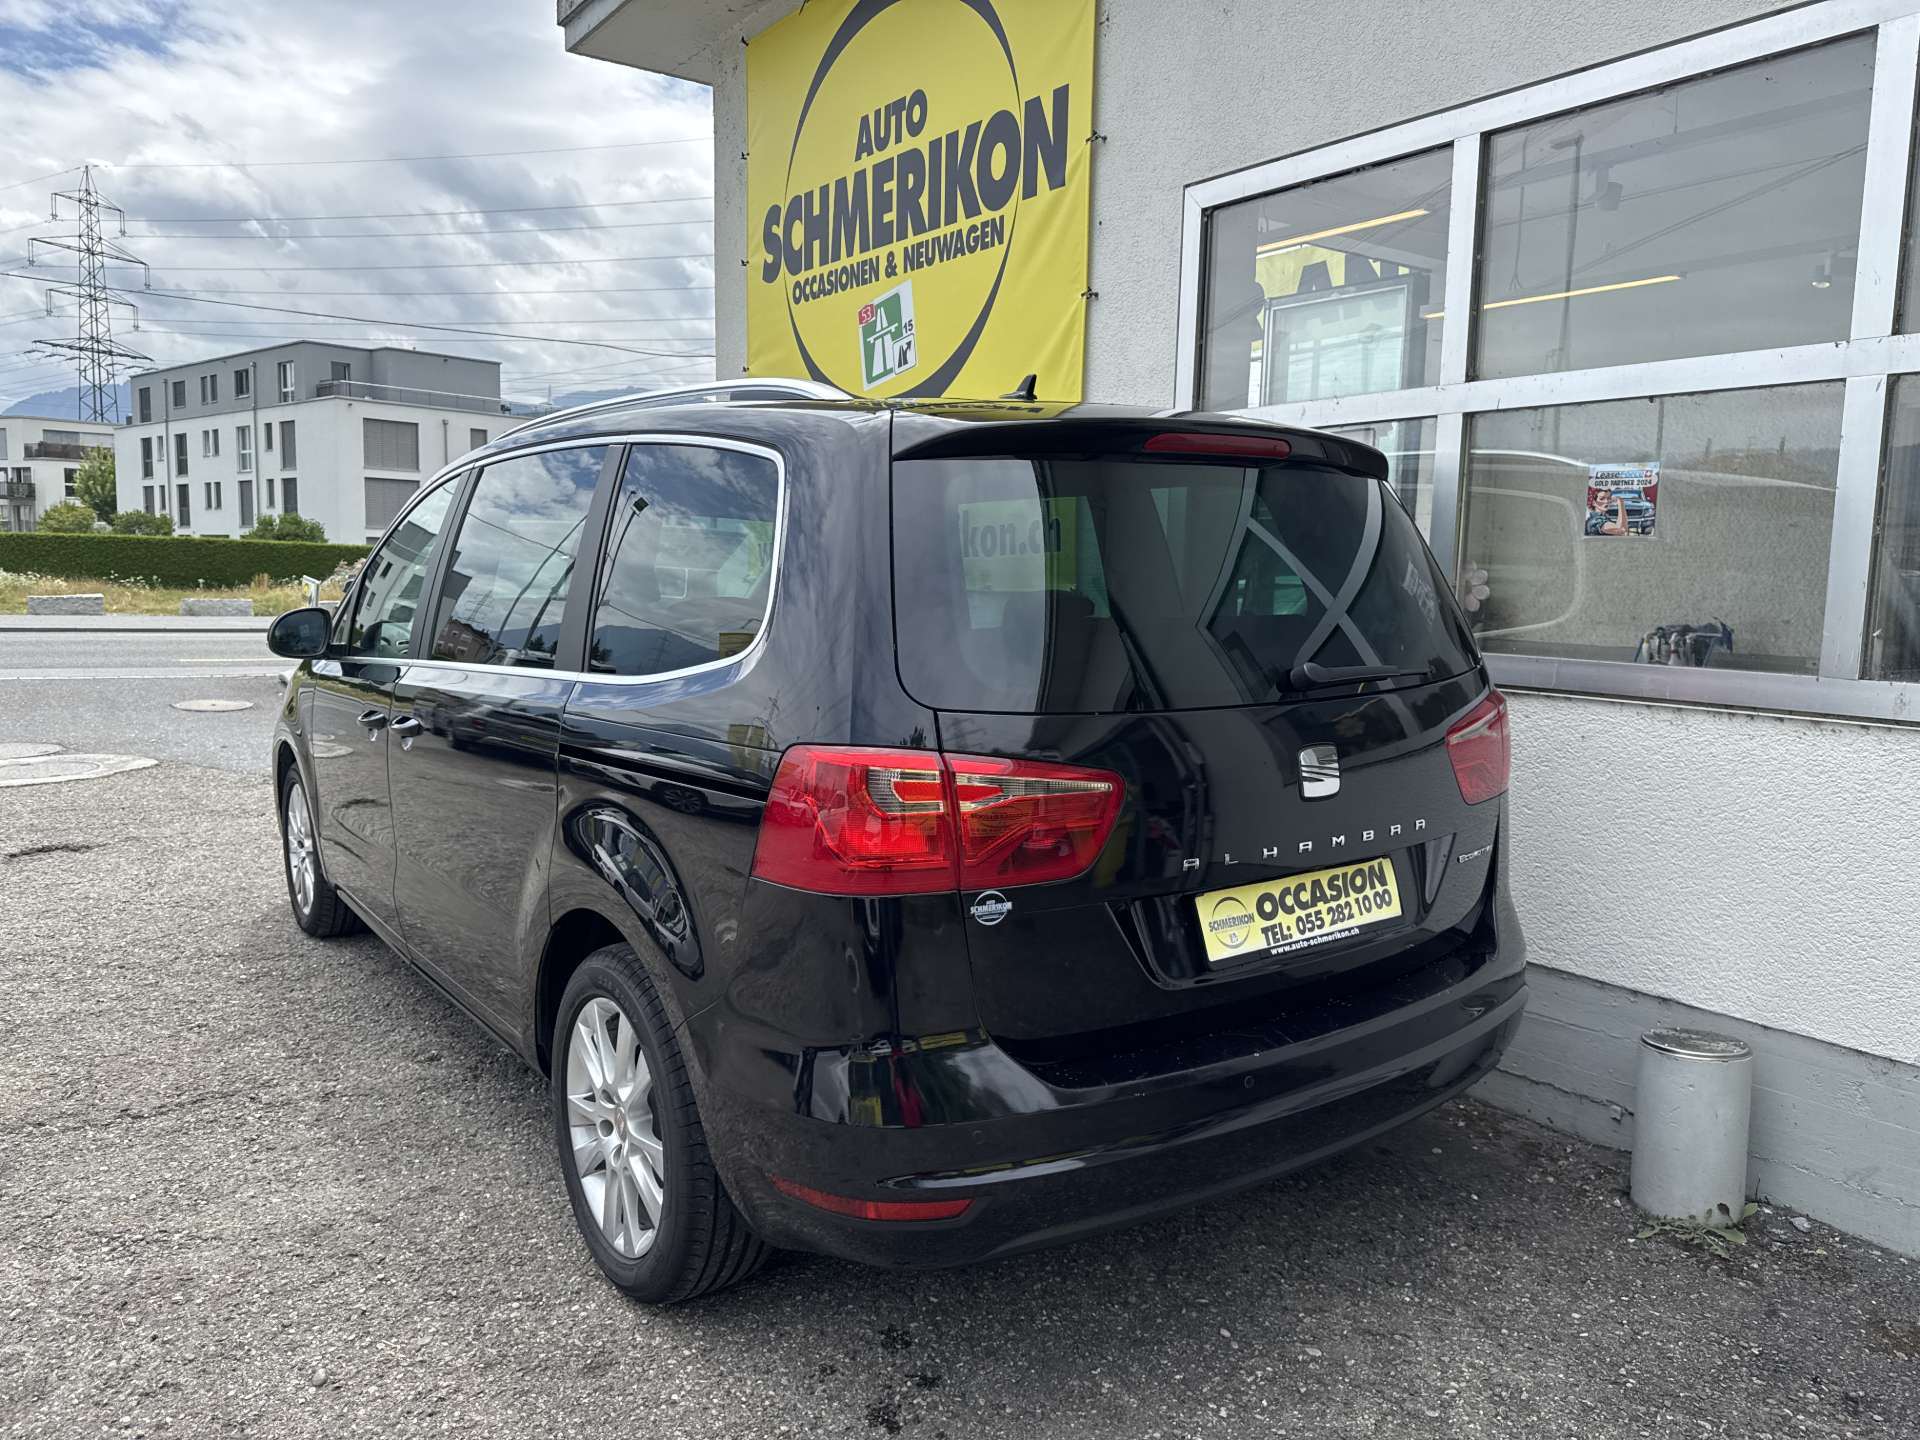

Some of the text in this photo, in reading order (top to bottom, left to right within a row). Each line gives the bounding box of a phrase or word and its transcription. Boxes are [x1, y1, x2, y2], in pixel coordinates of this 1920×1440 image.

[854, 89, 928, 162] AUTO
[762, 83, 1070, 284] SCHMERIKON
[792, 215, 1005, 305] OCCASIONEN & NEUWAGEN
[903, 319, 914, 333] 15
[1183, 819, 1426, 871] ALHAMBRA
[1256, 861, 1388, 922] OCCASION
[1261, 924, 1293, 947] TEL:
[1296, 909, 1325, 937] 055
[1327, 901, 1355, 927] 282
[1357, 893, 1373, 917] 10
[1373, 888, 1392, 910] 00
[1208, 912, 1255, 932] SCHMERIKON
[1270, 927, 1360, 956] www.auto-schmerikon.ch
